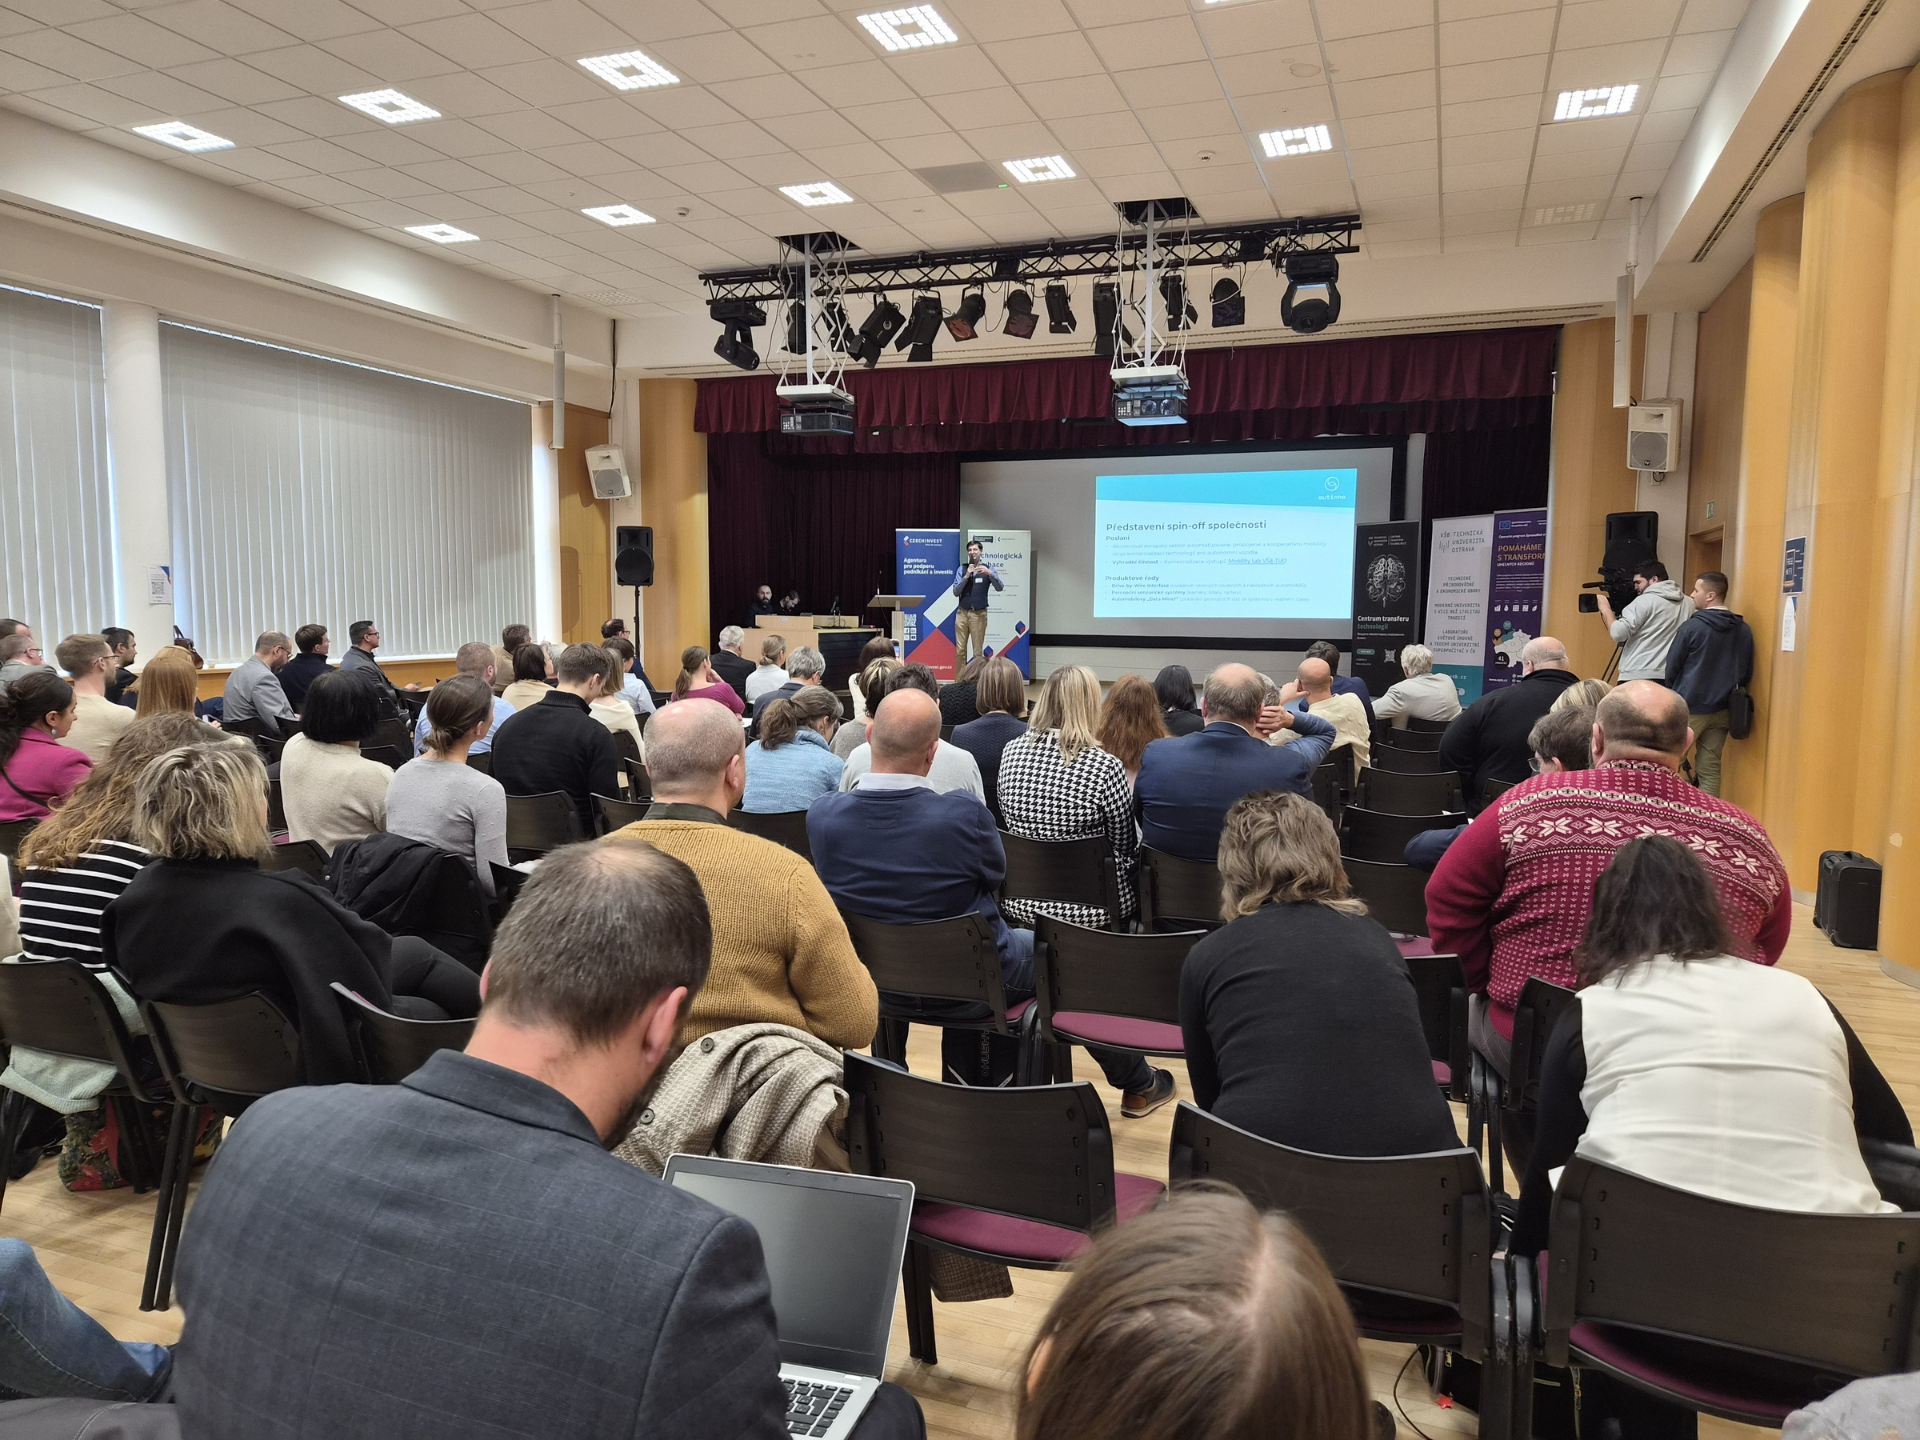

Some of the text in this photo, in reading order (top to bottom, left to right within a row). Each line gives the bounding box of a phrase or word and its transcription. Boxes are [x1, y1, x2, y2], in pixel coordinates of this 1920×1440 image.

[1106, 520, 1267, 532] Představení spin-off společnosti
[1452, 528, 1483, 537] TECHNICKÁ
[1498, 543, 1542, 552] POMÁHÁME
[980, 552, 1022, 560] chnologická
[1357, 623, 1388, 631] technologií
